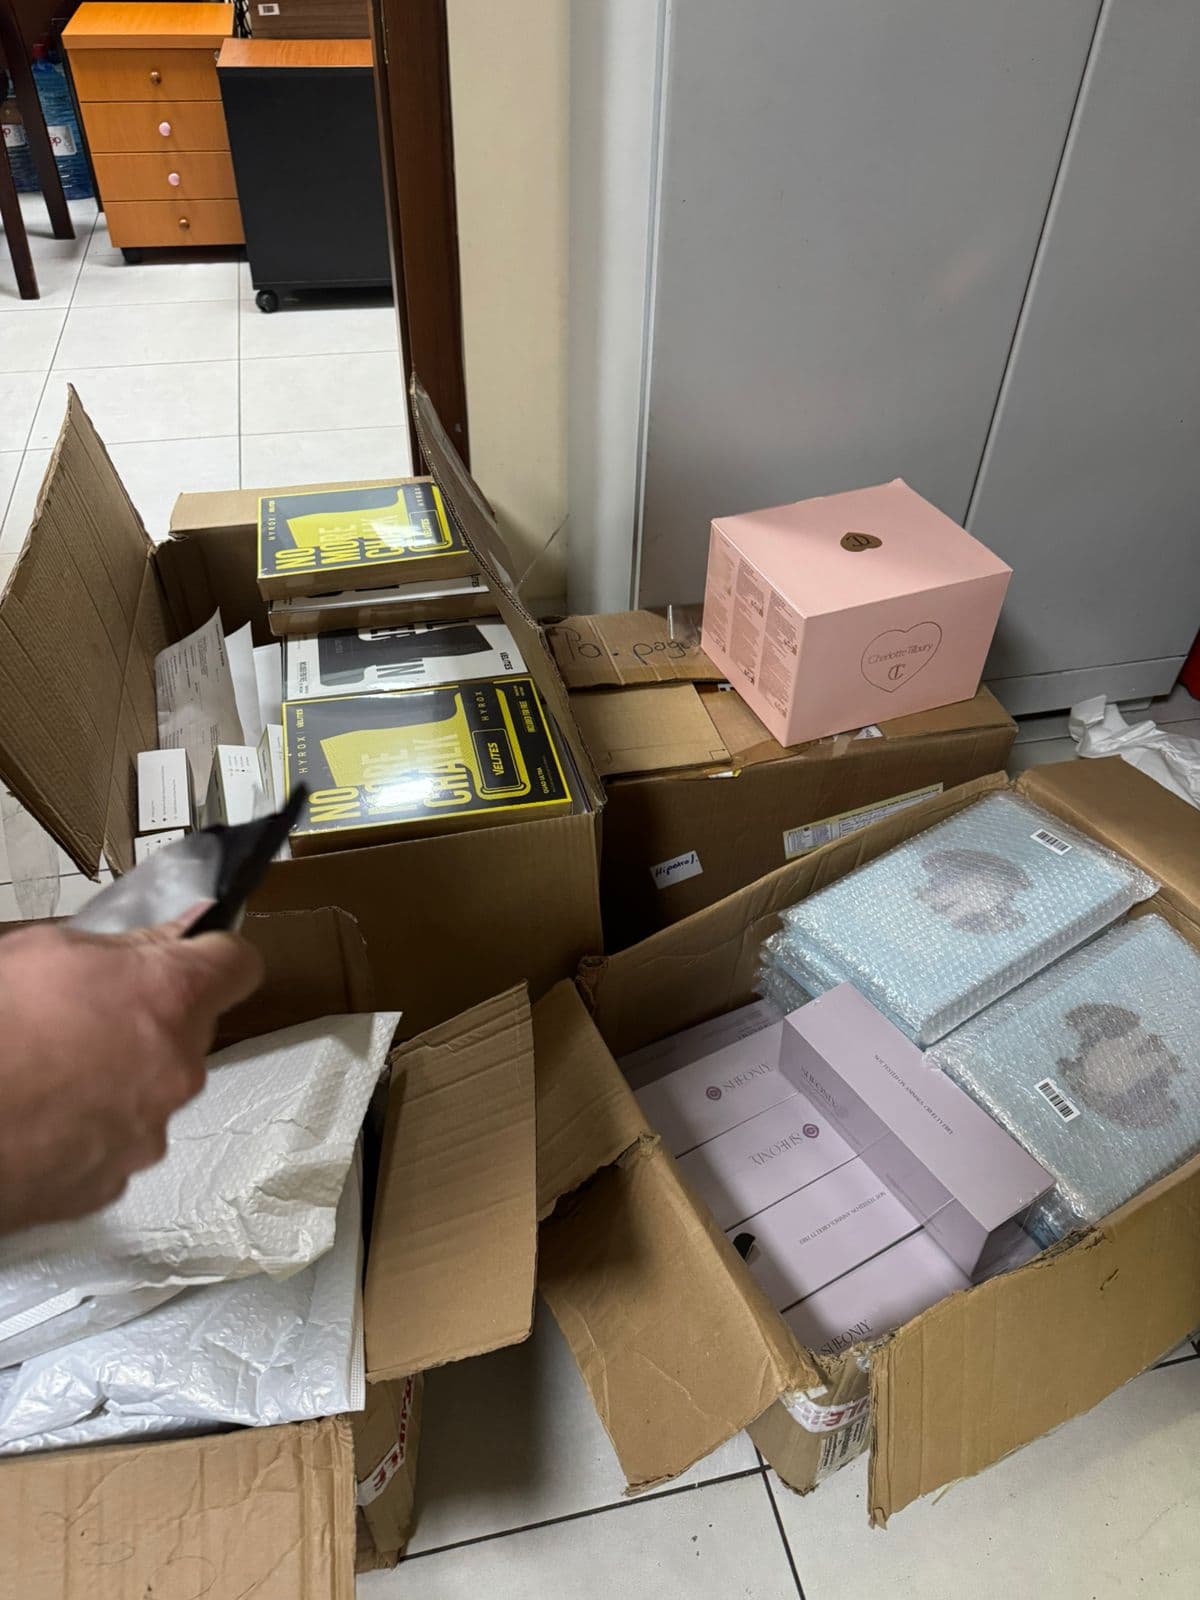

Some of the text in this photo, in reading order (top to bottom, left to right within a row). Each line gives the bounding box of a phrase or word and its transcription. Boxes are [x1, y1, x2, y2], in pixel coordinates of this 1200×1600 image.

[275, 548, 317, 570] NO
[318, 525, 361, 565] MORE
[474, 692, 489, 722] HYROX
[297, 735, 309, 775] HYROX
[412, 733, 472, 809] CHALK
[487, 742, 505, 777] VELITES
[309, 786, 361, 824] NO
